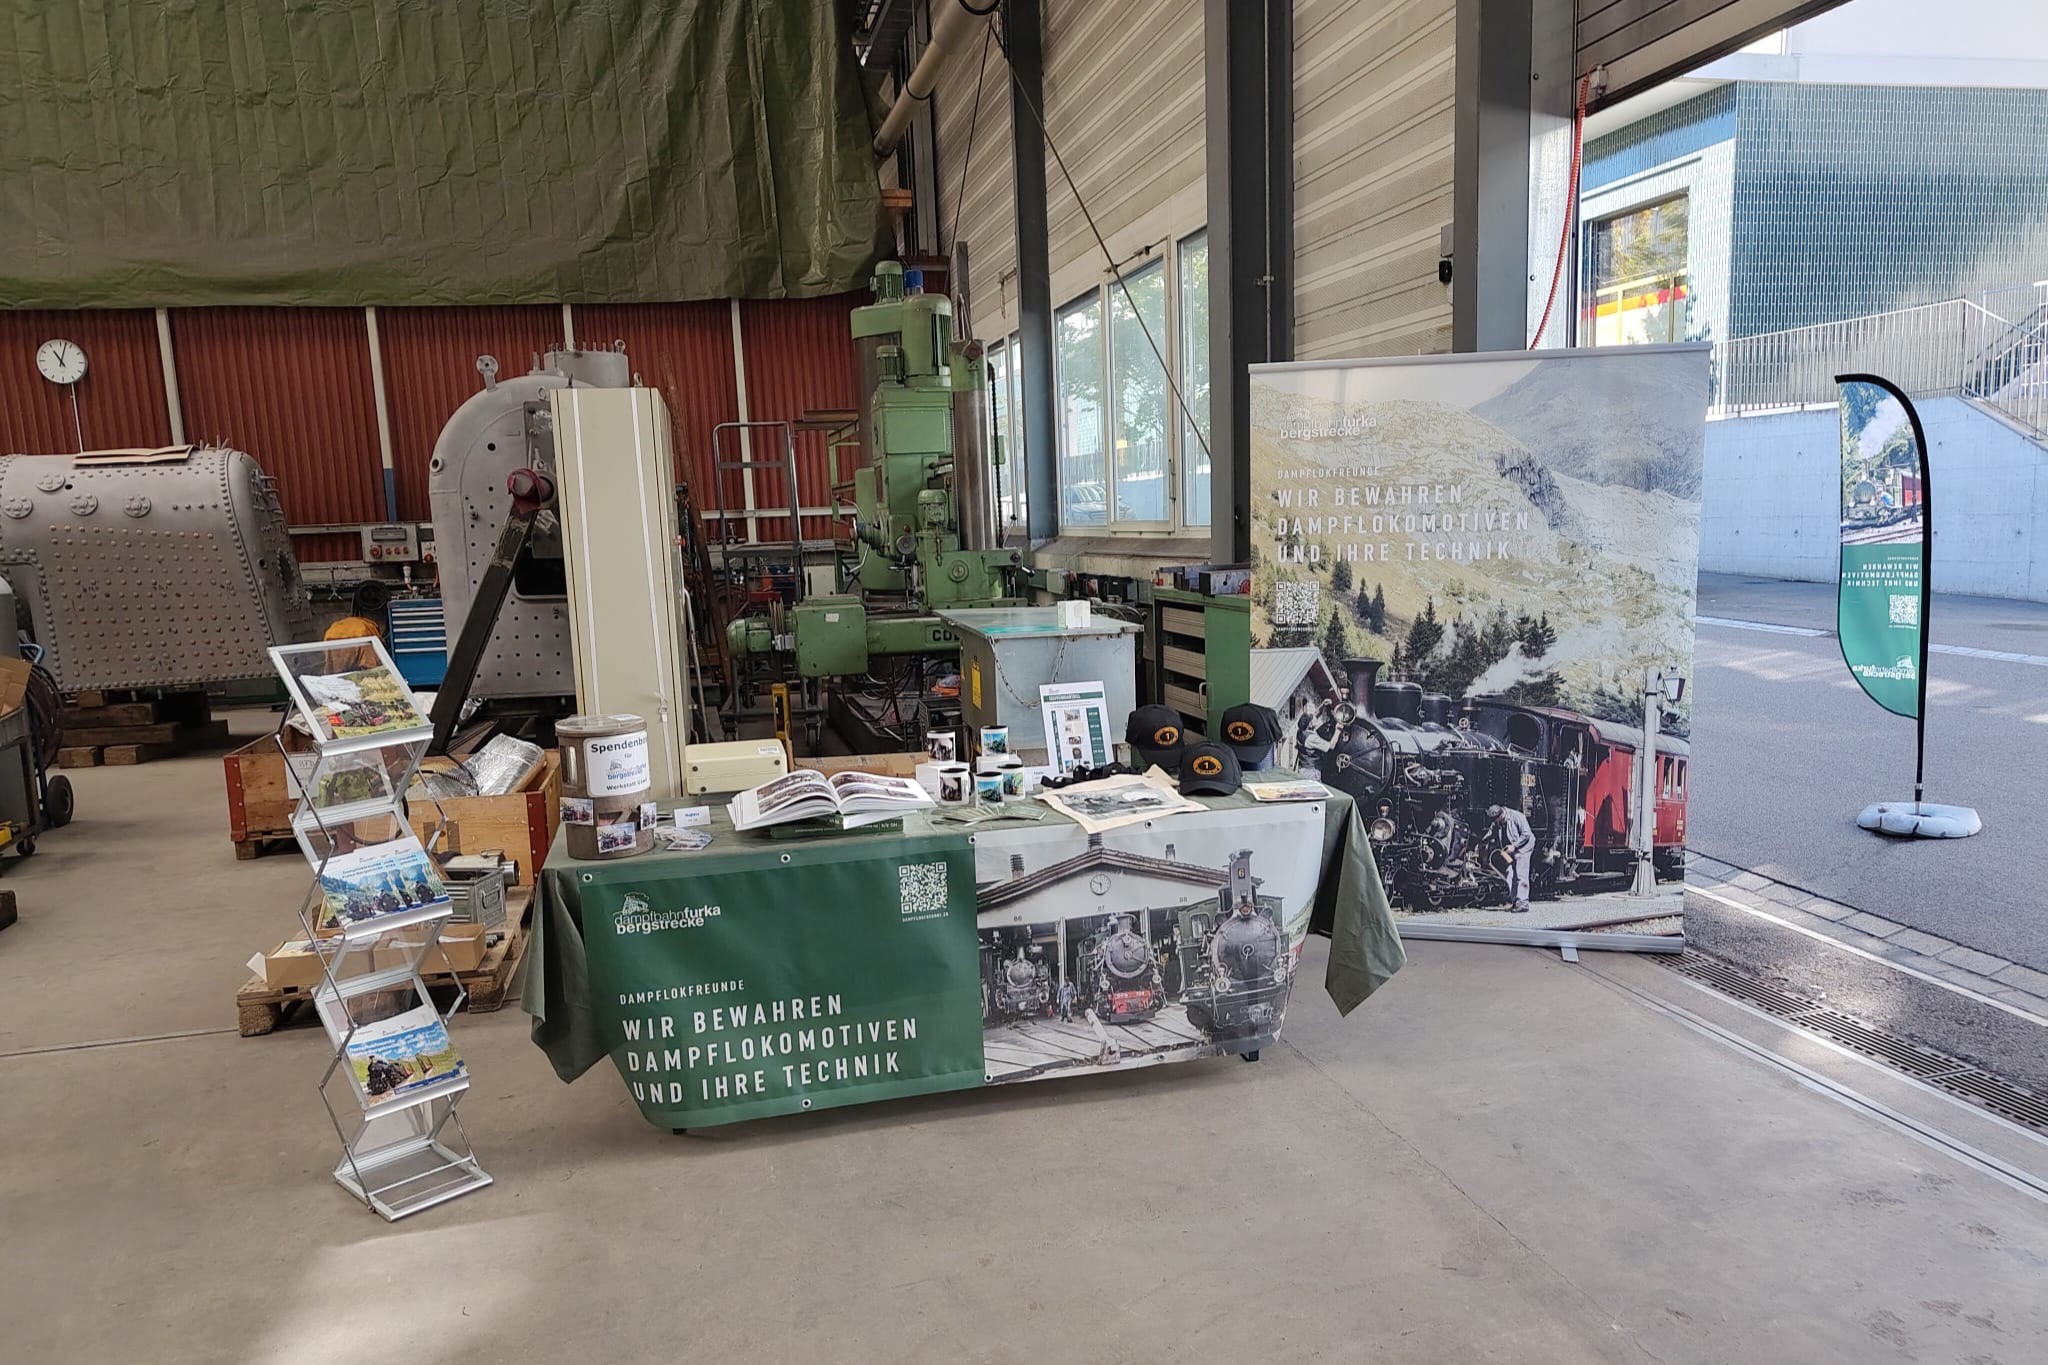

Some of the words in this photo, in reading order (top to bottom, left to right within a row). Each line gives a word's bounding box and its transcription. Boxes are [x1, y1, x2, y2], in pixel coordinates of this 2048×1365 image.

[1280, 426, 1360, 440] bergstrecke
[1278, 466, 1379, 479] DAMPFLOKFREUNDE
[1277, 489, 1320, 508] WIR
[1335, 484, 1463, 506] BEWAHREN
[1277, 511, 1529, 536] DAMPFLOKOMOTIVEN
[1277, 543, 1322, 563] UND
[1336, 543, 1389, 561] IHRE
[1406, 540, 1509, 561] TECHNIK
[591, 737, 648, 754] Spendenbo
[1239, 868, 1245, 878] 6
[614, 905, 721, 925] dampfbahnfurka
[616, 918, 704, 934] bergstrecke
[619, 979, 746, 1006] DAMPFLOKFREUNDE
[622, 1014, 675, 1041] WIR
[694, 994, 843, 1034] BEWAHREN
[627, 1017, 918, 1072] DAMPFLOKOMOTIVEN
[632, 1081, 684, 1104] UND
[701, 1070, 766, 1100] IHRE
[783, 1051, 901, 1088] TECHNIK
